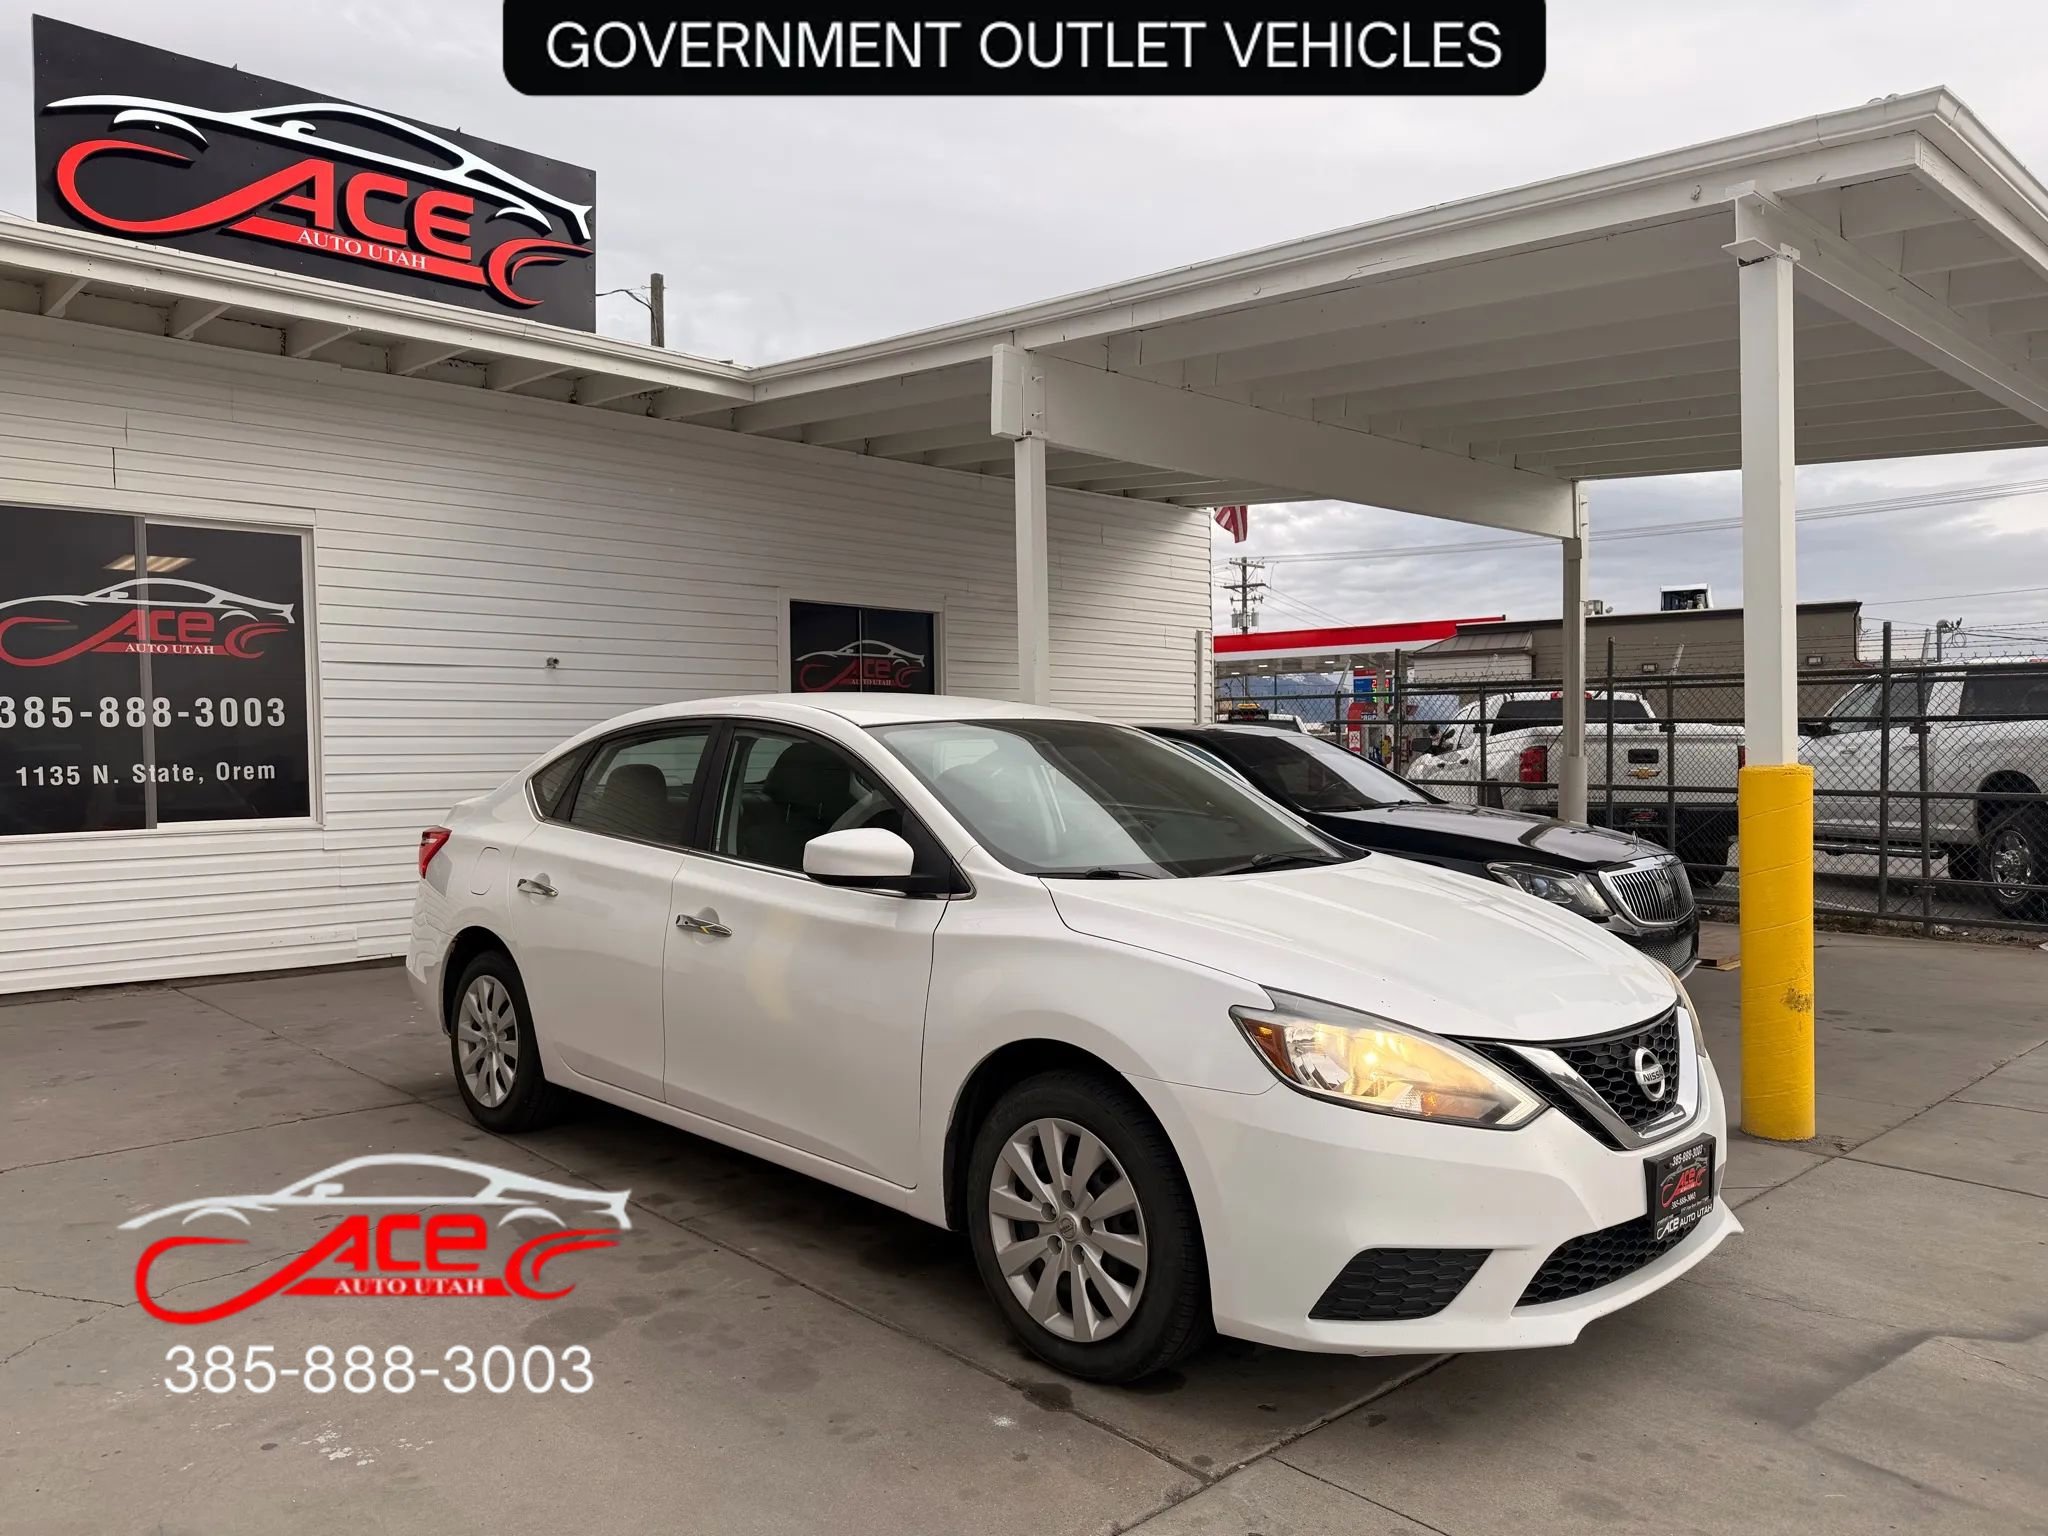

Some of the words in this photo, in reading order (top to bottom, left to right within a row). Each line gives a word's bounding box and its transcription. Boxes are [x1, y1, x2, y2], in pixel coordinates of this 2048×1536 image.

[297, 229, 362, 255] AUTO
[368, 244, 427, 270] UTAH
[124, 642, 168, 655] AUTO
[172, 643, 215, 655] UTAH
[0, 696, 286, 729] 385-888-3003
[16, 765, 81, 786] 1135
[93, 764, 119, 785] N.
[132, 763, 204, 785] State,
[216, 761, 276, 781] Orem
[1680, 1212, 1696, 1227] AUTO
[1696, 1204, 1713, 1218] UTAH
